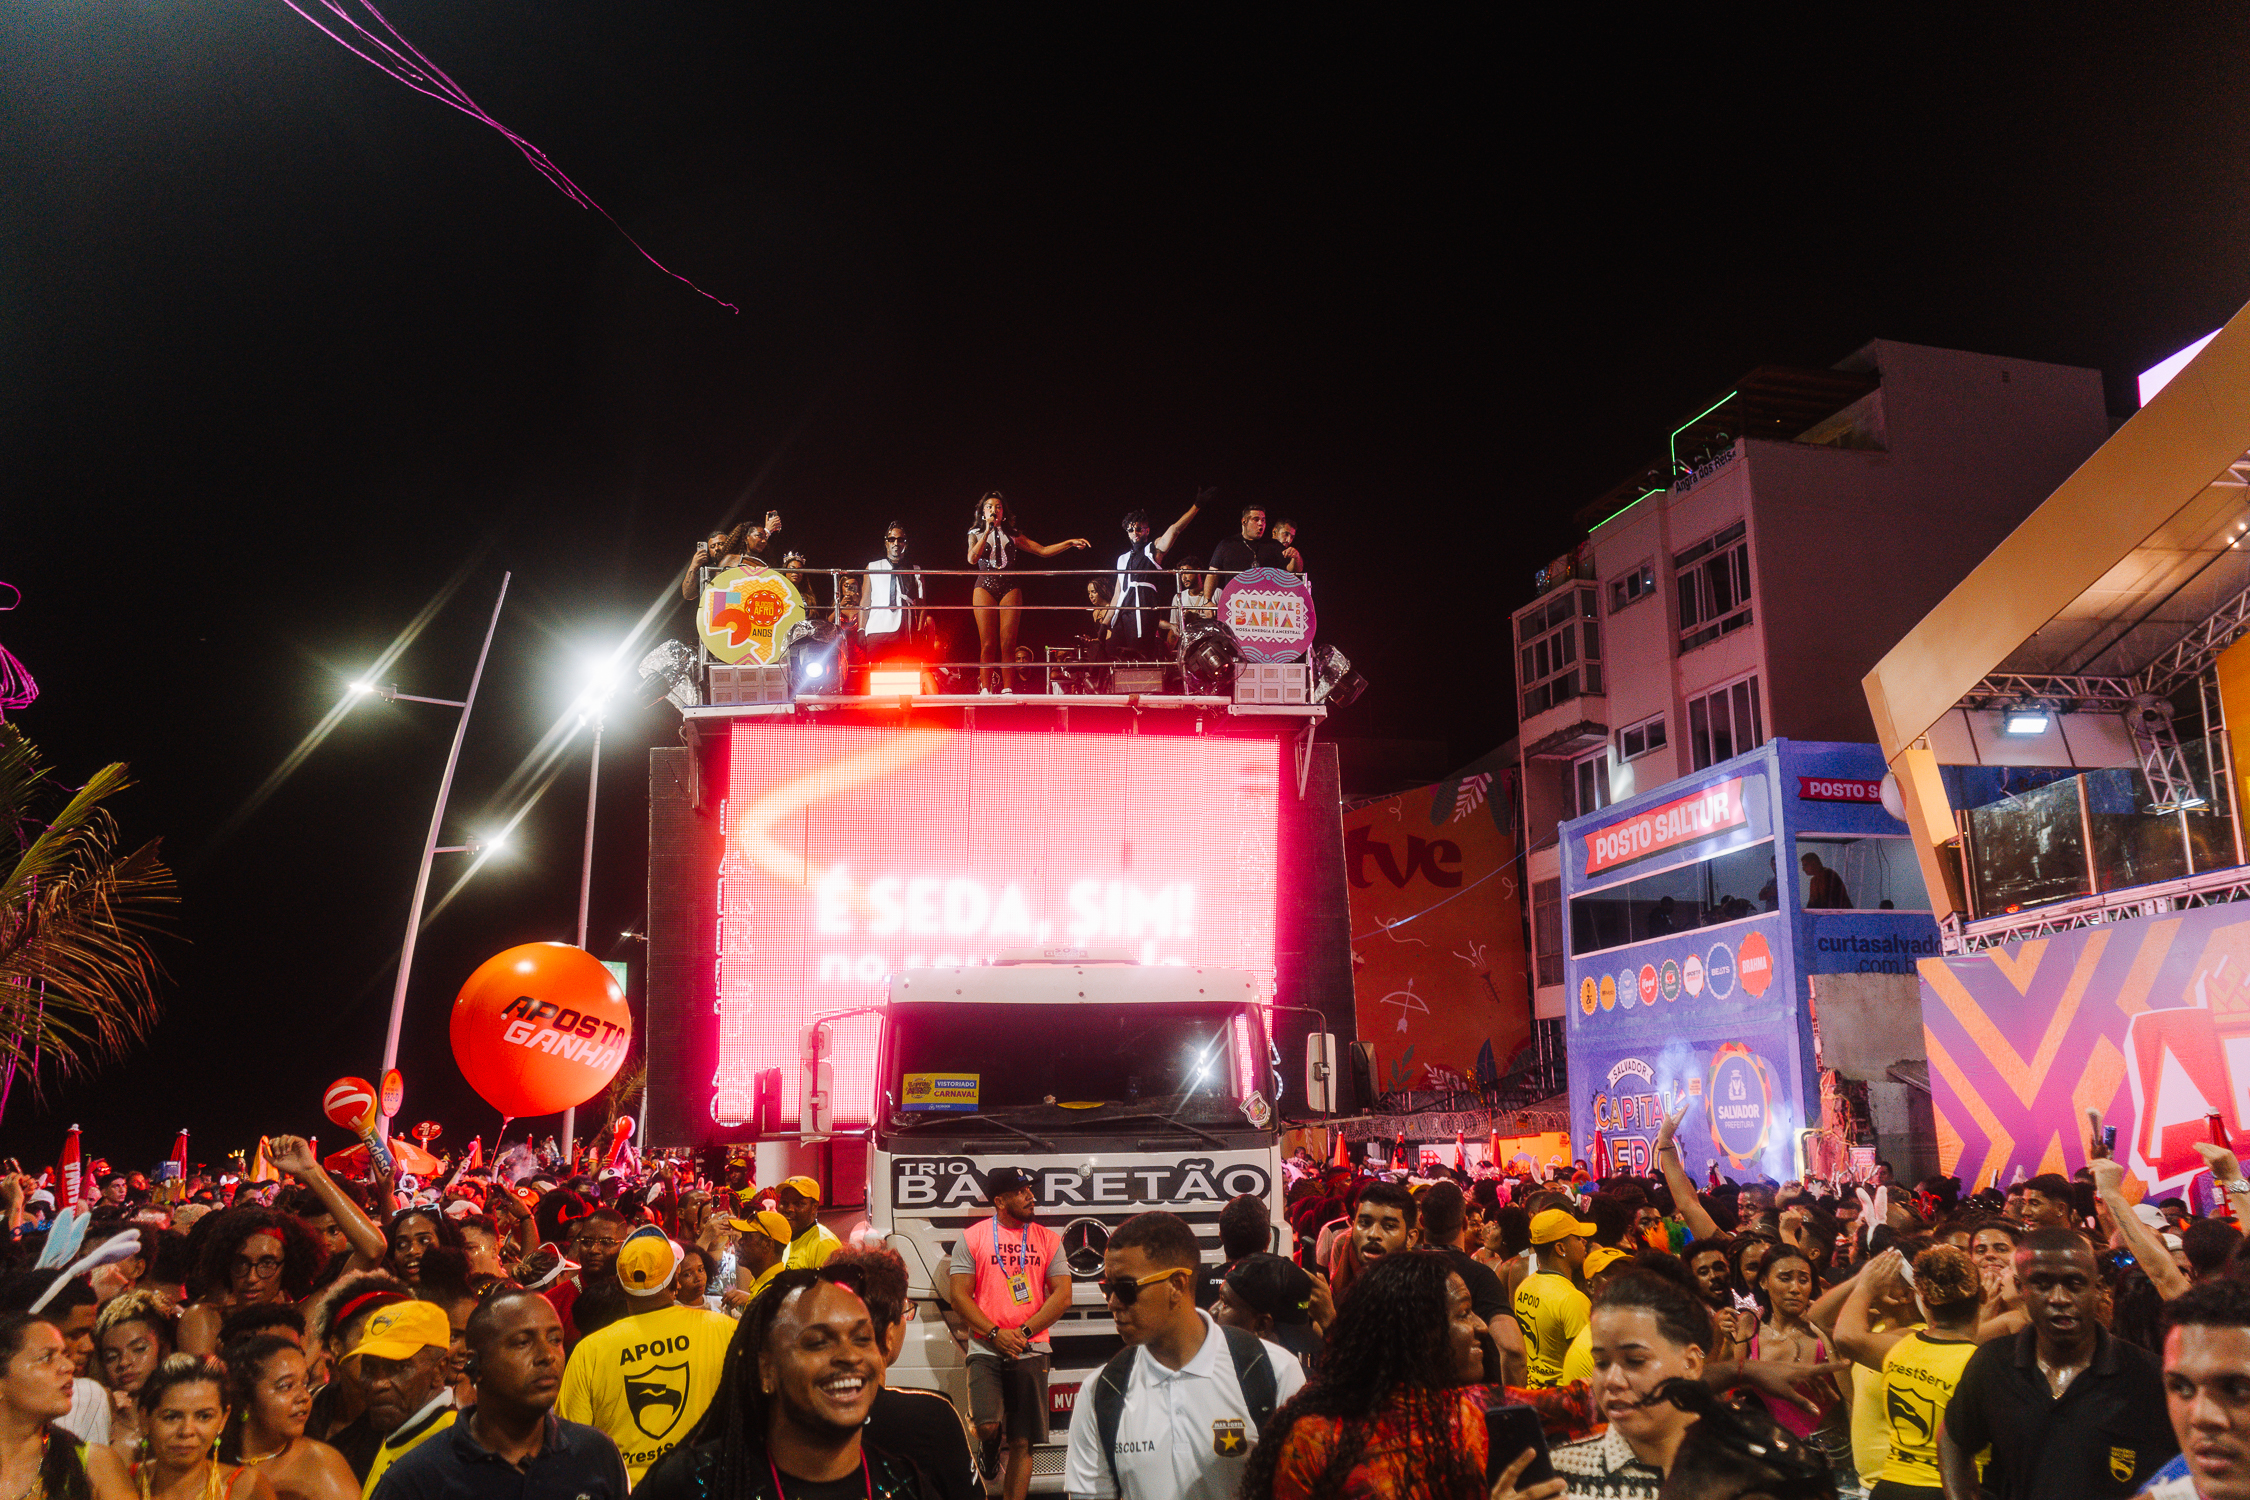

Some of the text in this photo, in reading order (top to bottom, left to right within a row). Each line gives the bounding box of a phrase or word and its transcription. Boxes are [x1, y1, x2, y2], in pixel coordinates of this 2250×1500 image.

[754, 606, 774, 616] AFRO
[1235, 599, 1294, 612] CARNAVAL
[1235, 610, 1293, 628] BAHIA
[752, 629, 773, 638] ANOS
[1810, 781, 1883, 798] POSTO S
[1595, 791, 1730, 865] POSTO SALTUR
[817, 861, 1196, 942] É SEDA, SIM!
[1817, 934, 1943, 954] curtasalvado
[1742, 956, 1768, 974] BRAHMA
[1855, 955, 1917, 975] .com.b
[501, 995, 626, 1050] APOSTA
[503, 1020, 616, 1070] GANHA
[1612, 1061, 1647, 1081] SALVADOR
[934, 1090, 977, 1098] CARNAVAL
[1718, 1104, 1760, 1120] SALVADOR
[1724, 1120, 1755, 1129] PREFEITURA
[359, 1126, 391, 1177] bradesc
[900, 1162, 968, 1176] TRIO
[898, 1163, 1266, 1204] BARETÃO
[998, 1243, 1038, 1254] FISCAL
[991, 1255, 1041, 1267] DE PISTA
[1517, 1291, 1540, 1309] APOIO
[620, 1335, 690, 1366] APOIO
[622, 1442, 675, 1464] PrestS
[1114, 1440, 1155, 1454] ESCOLTA
